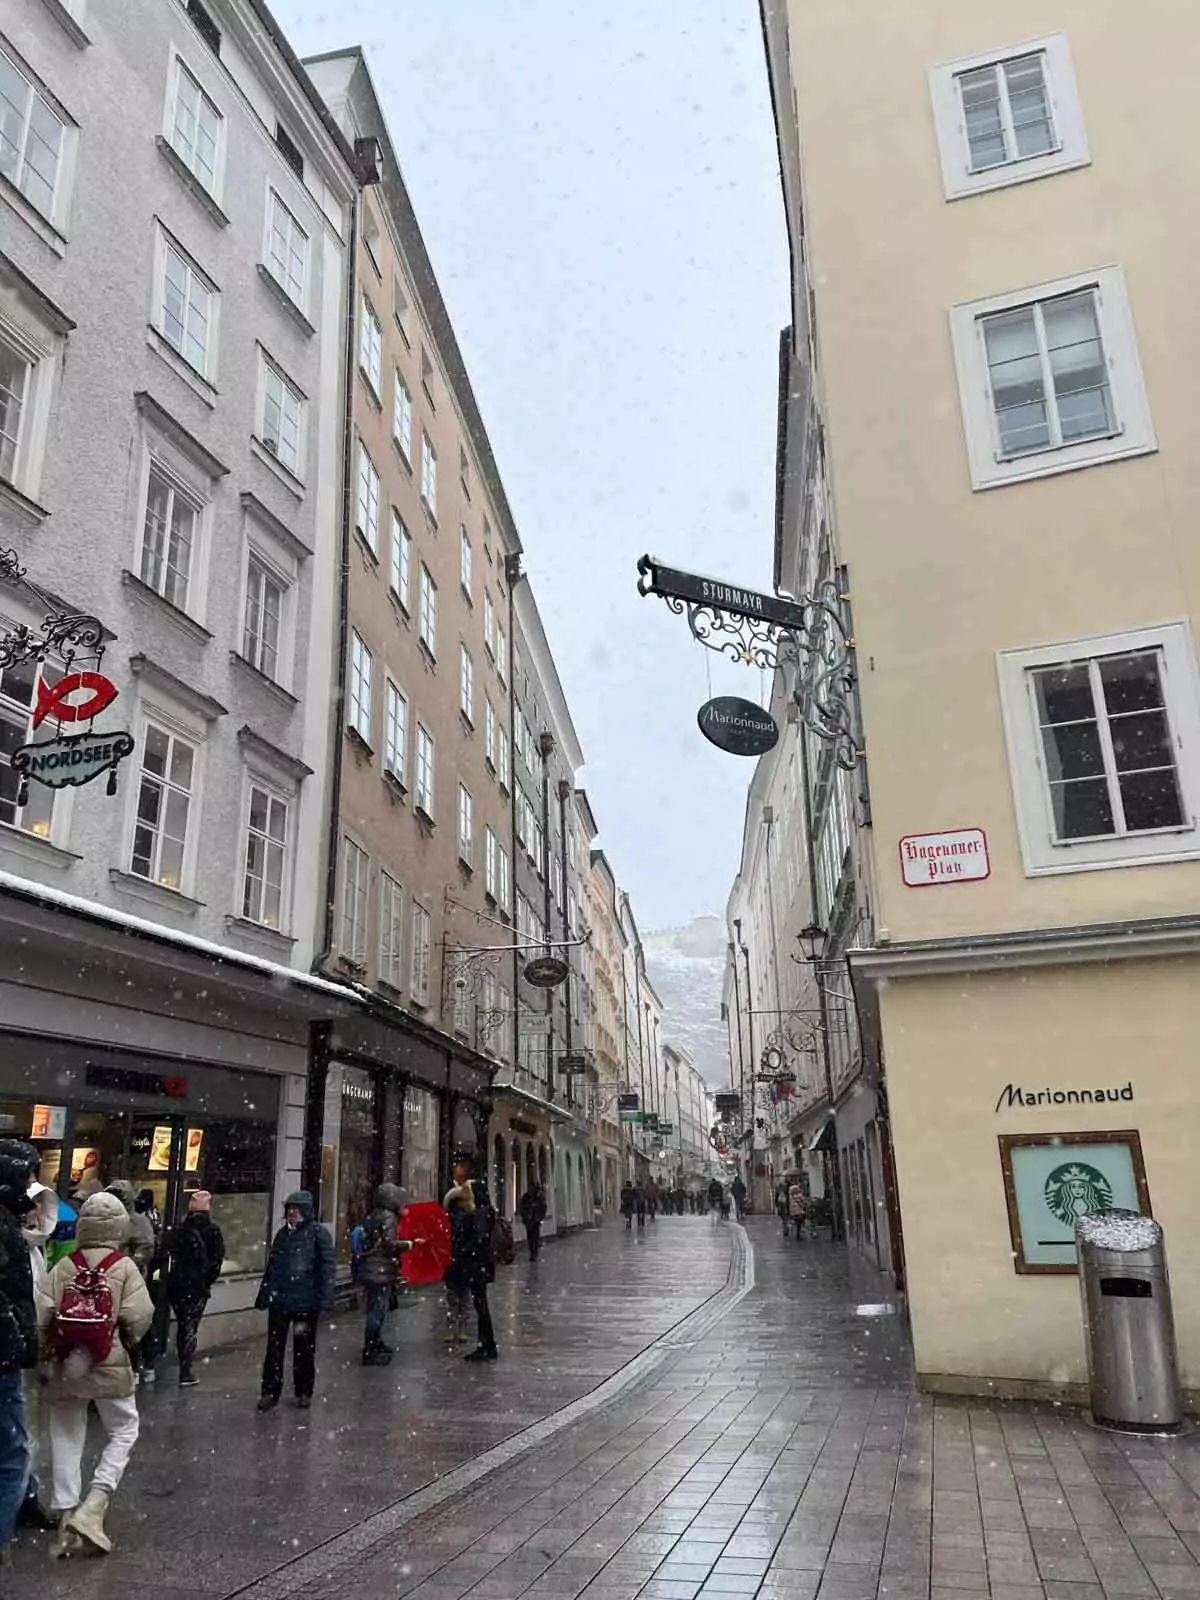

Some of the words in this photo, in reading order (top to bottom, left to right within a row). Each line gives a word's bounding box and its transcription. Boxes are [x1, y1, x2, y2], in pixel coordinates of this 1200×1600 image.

[702, 581, 763, 612] STURMAYR
[702, 705, 775, 733] Marionnaud
[31, 743, 112, 772] NORDSEE
[994, 1081, 1135, 1113] Marionnaud
